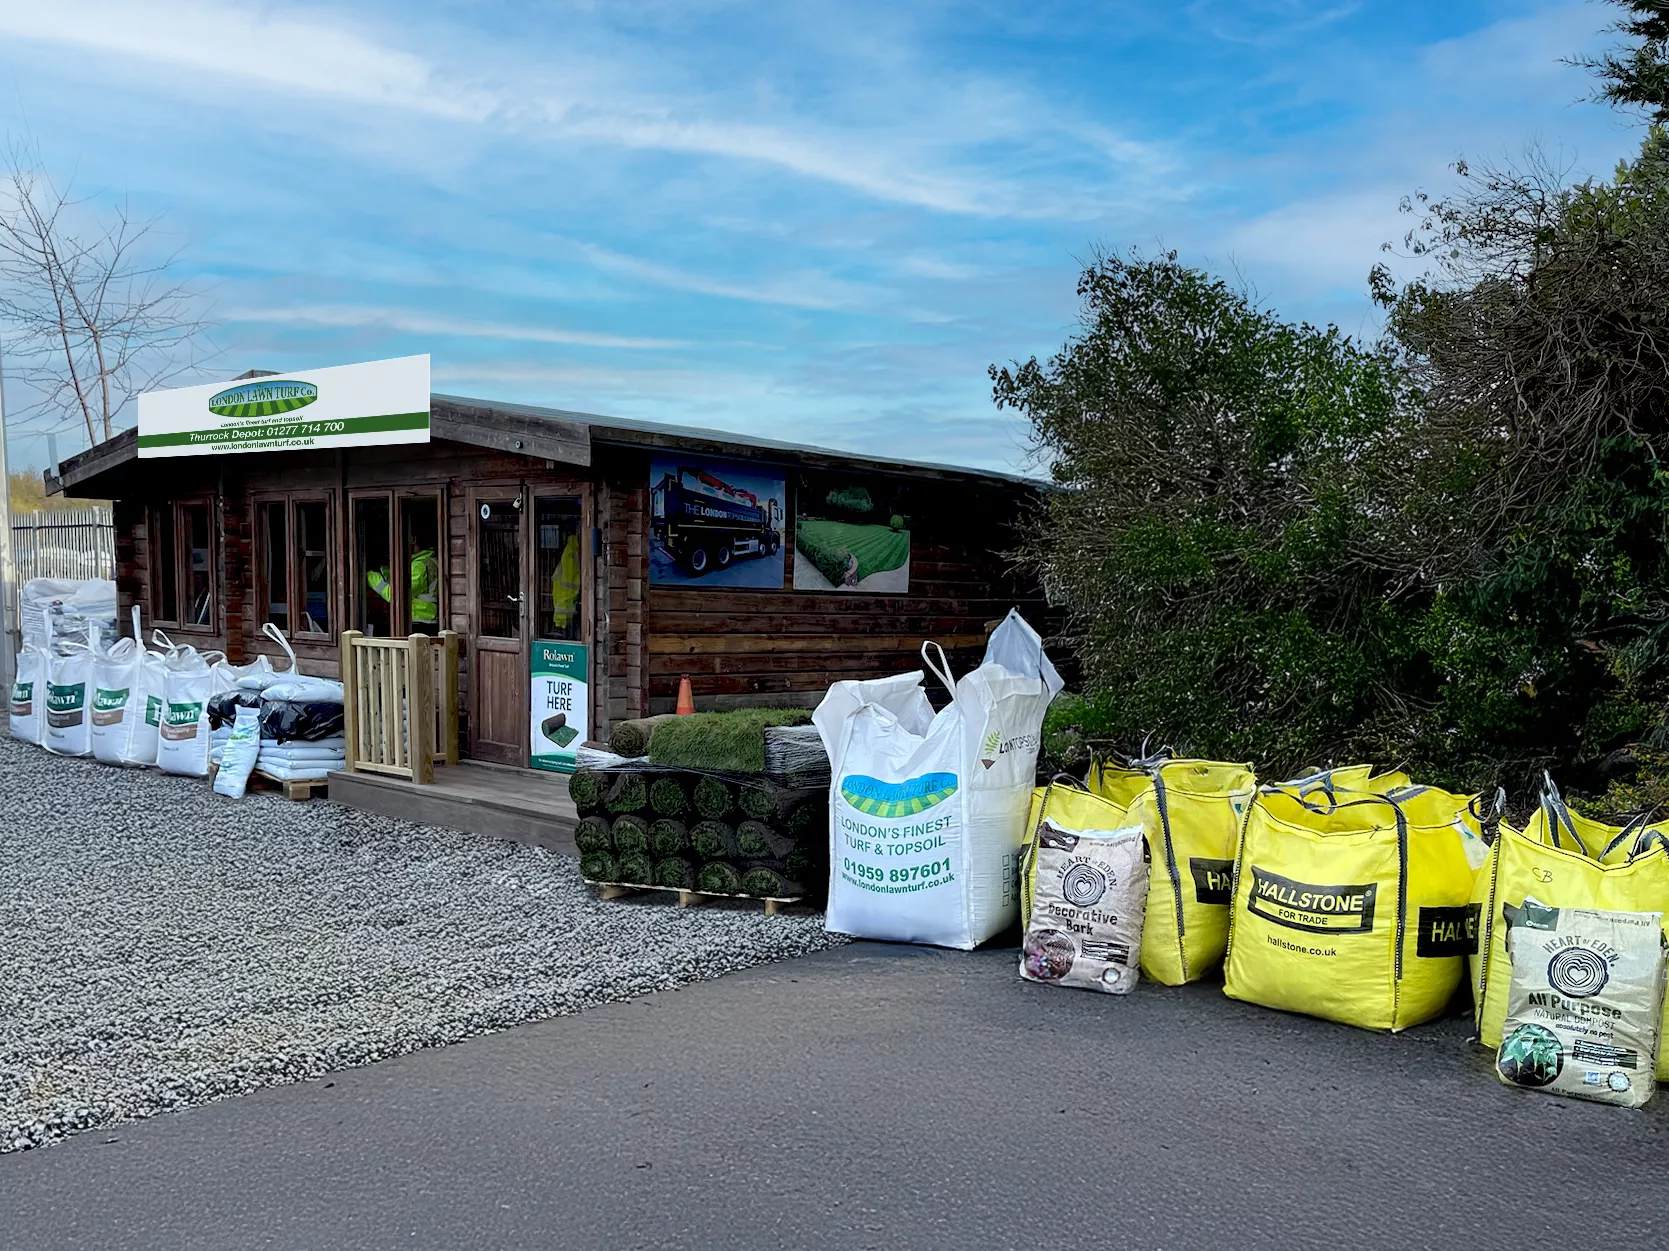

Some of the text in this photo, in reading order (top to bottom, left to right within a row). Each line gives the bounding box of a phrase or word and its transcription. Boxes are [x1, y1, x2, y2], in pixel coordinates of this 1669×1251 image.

[211, 386, 315, 407] LONDON LAWN TURF Co.
[189, 421, 345, 442] Thurrock Depot: 01277 714 700
[211, 438, 315, 451] www.londonlawnturf.co.uk
[684, 502, 700, 516] THE
[701, 506, 727, 519] LONDON
[543, 649, 574, 663] Rolawn
[547, 680, 572, 696] TURF
[547, 696, 572, 711] HERE
[841, 815, 952, 839] LONDON'S FINEST
[844, 833, 946, 856] TURF & TOPSOIL
[844, 857, 951, 882] 01959 897601
[1056, 856, 1091, 879] HEART
[841, 871, 955, 894] www.londonlawnturf.co.uk
[1257, 878, 1364, 912] HALLSTONE
[1048, 902, 1118, 926] Decorative
[1278, 908, 1328, 926] FOR TRADE
[1066, 918, 1095, 936] Bark
[1267, 934, 1337, 957] hallstone.co.uk
[1542, 935, 1582, 954] HEART
[1528, 991, 1622, 1021] All Purpose
[1533, 1008, 1616, 1030] NATURAL COMPOST
[1555, 1022, 1589, 1035] absolutely
